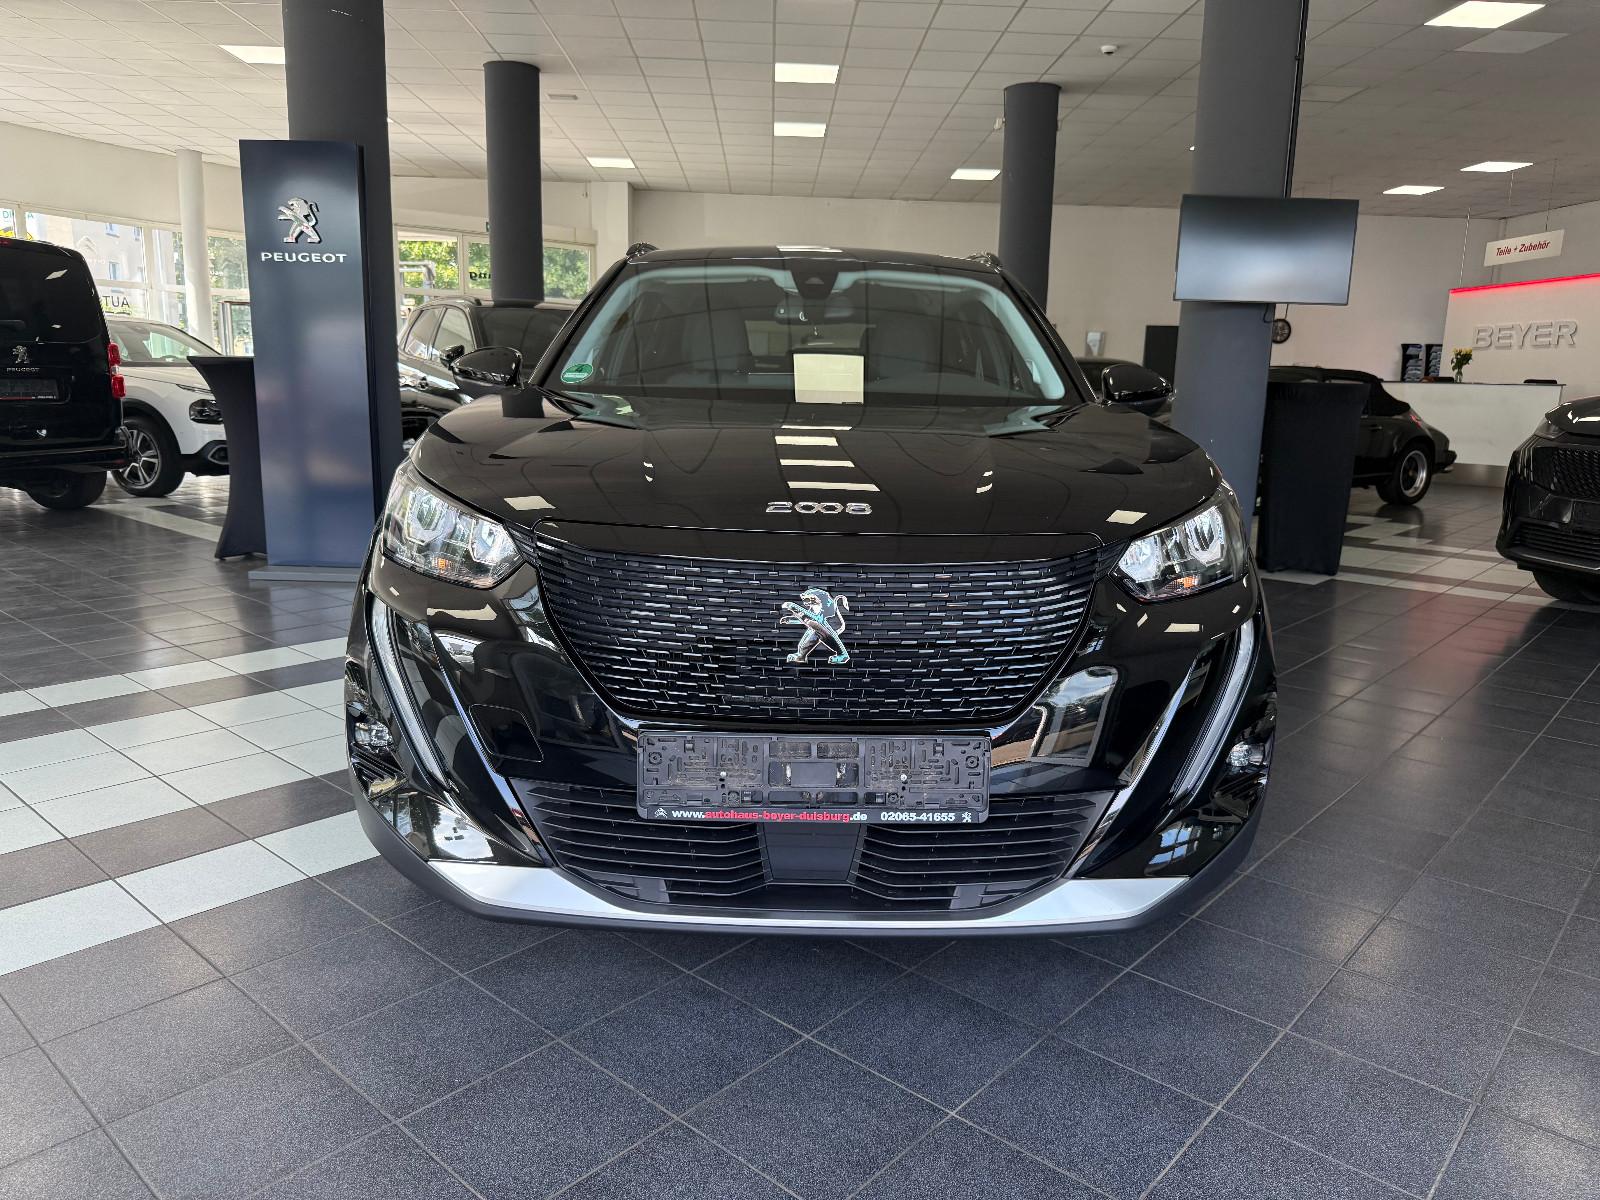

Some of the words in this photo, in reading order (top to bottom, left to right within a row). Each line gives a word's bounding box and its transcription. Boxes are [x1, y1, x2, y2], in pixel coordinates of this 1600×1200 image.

[1496, 247, 1512, 256] Teile
[1518, 240, 1551, 253] Zubehör
[260, 252, 348, 263] PEUGEOT
[1472, 320, 1578, 350] BEYER
[765, 501, 873, 515] 2008
[671, 809, 868, 823] www.autohaus-beyer-duisburg.de
[880, 811, 956, 822] 02065-41655
